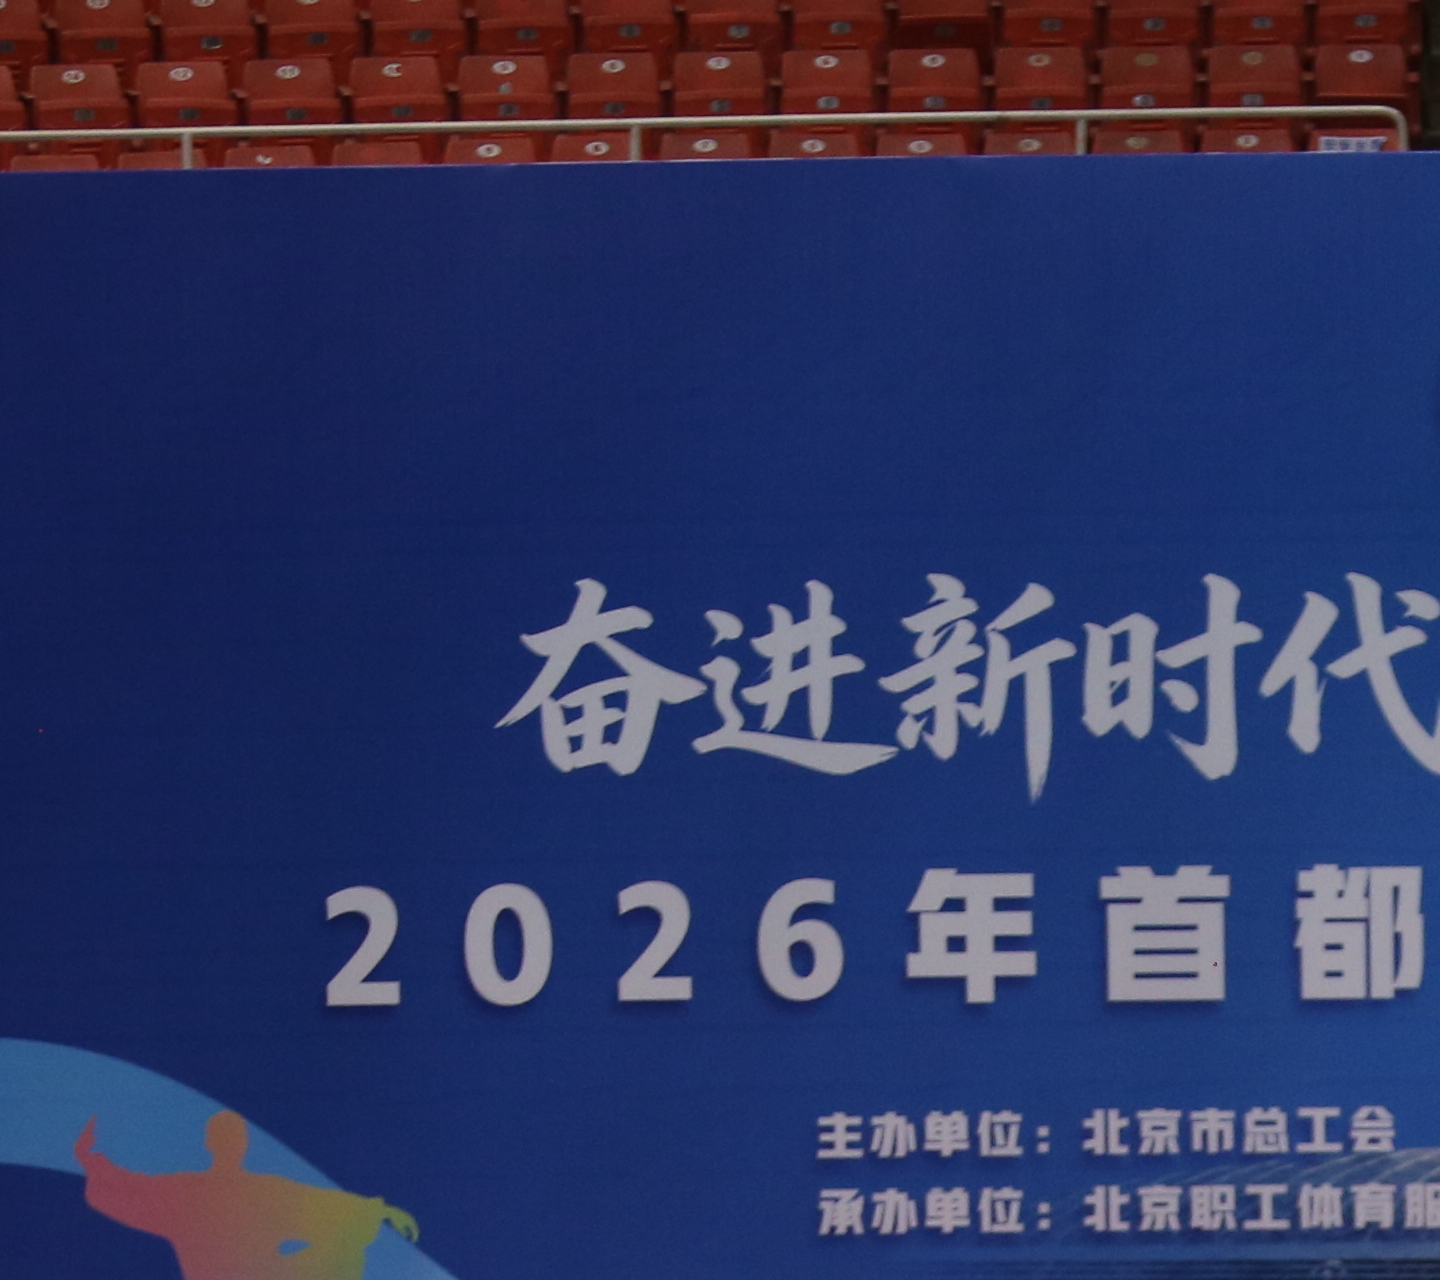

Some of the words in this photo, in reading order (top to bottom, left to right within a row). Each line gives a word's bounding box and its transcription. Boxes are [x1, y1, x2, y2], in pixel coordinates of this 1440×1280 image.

[816, 1106, 1394, 1159] 主办单位：北京市总工会
